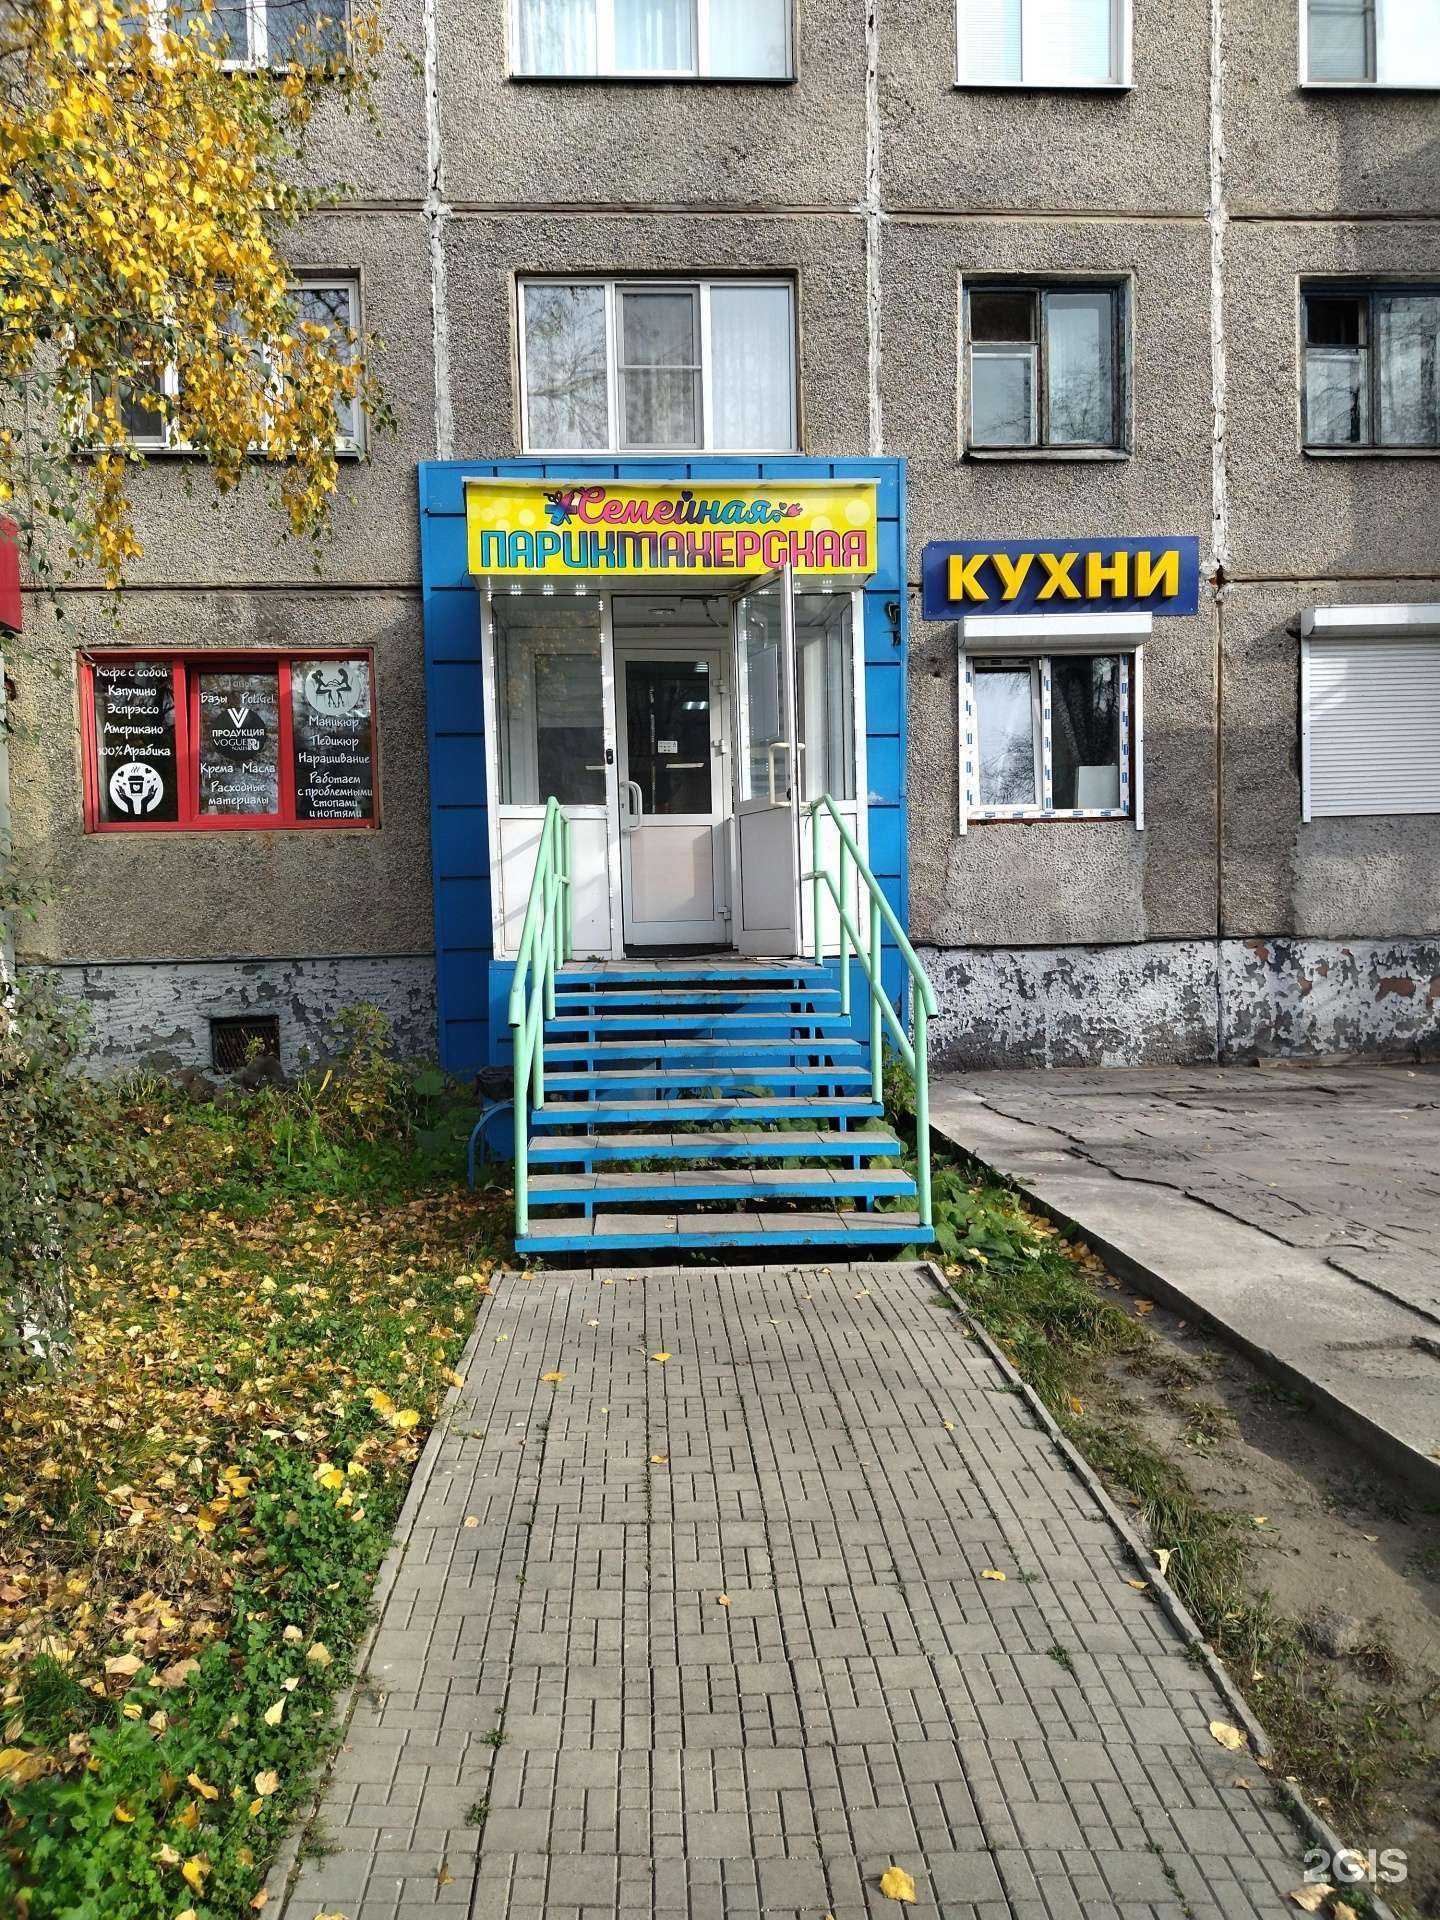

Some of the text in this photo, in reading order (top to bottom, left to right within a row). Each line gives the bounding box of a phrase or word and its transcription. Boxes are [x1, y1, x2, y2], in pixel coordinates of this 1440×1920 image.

[575, 486, 773, 525] Семейная
[480, 529, 868, 568] ПАРИКМАХЕРСКАЯ
[947, 550, 1180, 601] КУХНИ
[96, 665, 168, 682] Кофе с собой
[107, 684, 157, 701] Капучино
[200, 691, 228, 705] Базы
[107, 703, 159, 720] Эспрэссо
[103, 721, 164, 740] Американо
[308, 715, 360, 733] Маникюр
[212, 728, 265, 739] ПРОДУКЦИЯ
[310, 734, 360, 752] Педикюр
[200, 762, 276, 779] Крема Масла
[309, 771, 361, 784] Работаем
[210, 780, 266, 792] Расходные
[297, 784, 373, 801] с проблемными
[209, 796, 269, 809] материалы
[312, 799, 358, 807] стопами
[309, 809, 362, 818] и ногтями
